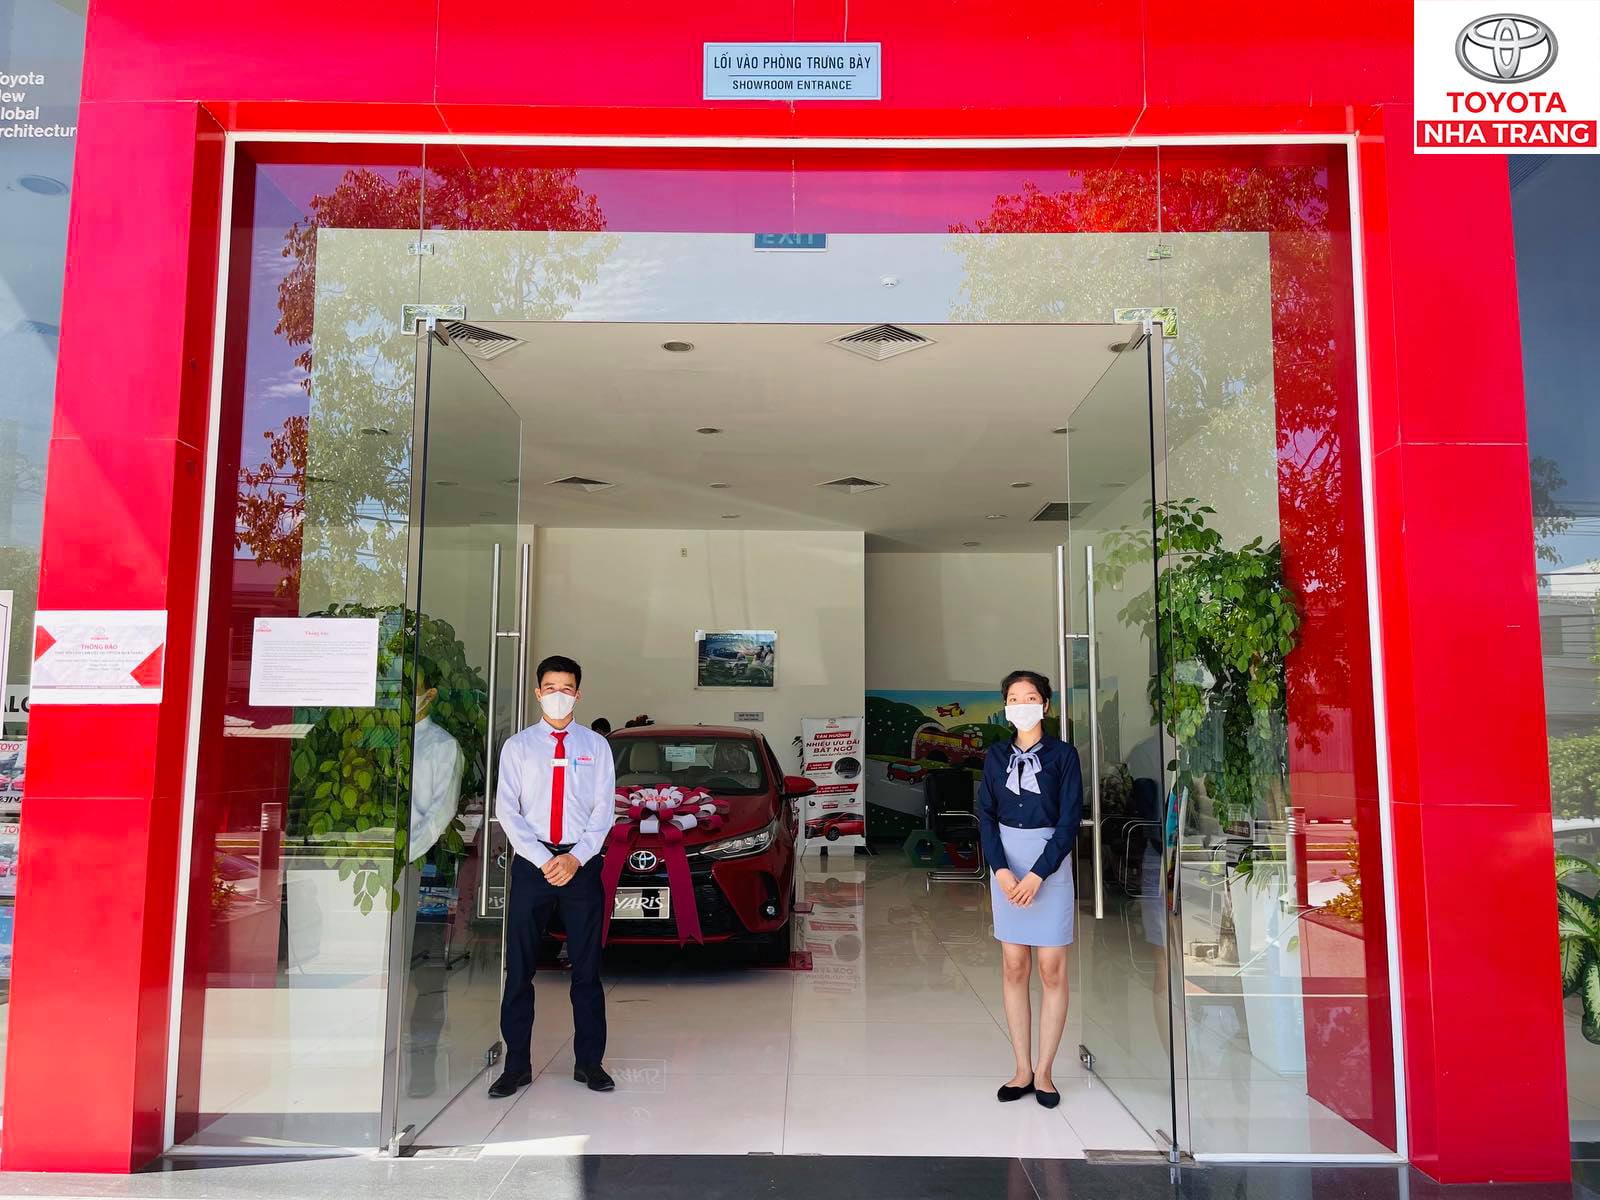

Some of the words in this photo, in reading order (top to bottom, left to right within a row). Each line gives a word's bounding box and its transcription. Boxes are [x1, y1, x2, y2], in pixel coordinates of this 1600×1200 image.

[714, 53, 731, 69] LỐI
[736, 54, 758, 69] VÀO
[763, 54, 801, 69] PHÒNG
[807, 55, 844, 69] TRƯNG
[849, 54, 871, 69] BÀY
[732, 80, 793, 90] SHOWROOM
[797, 80, 852, 90] ENTRANCE
[0, 106, 40, 120] lobal
